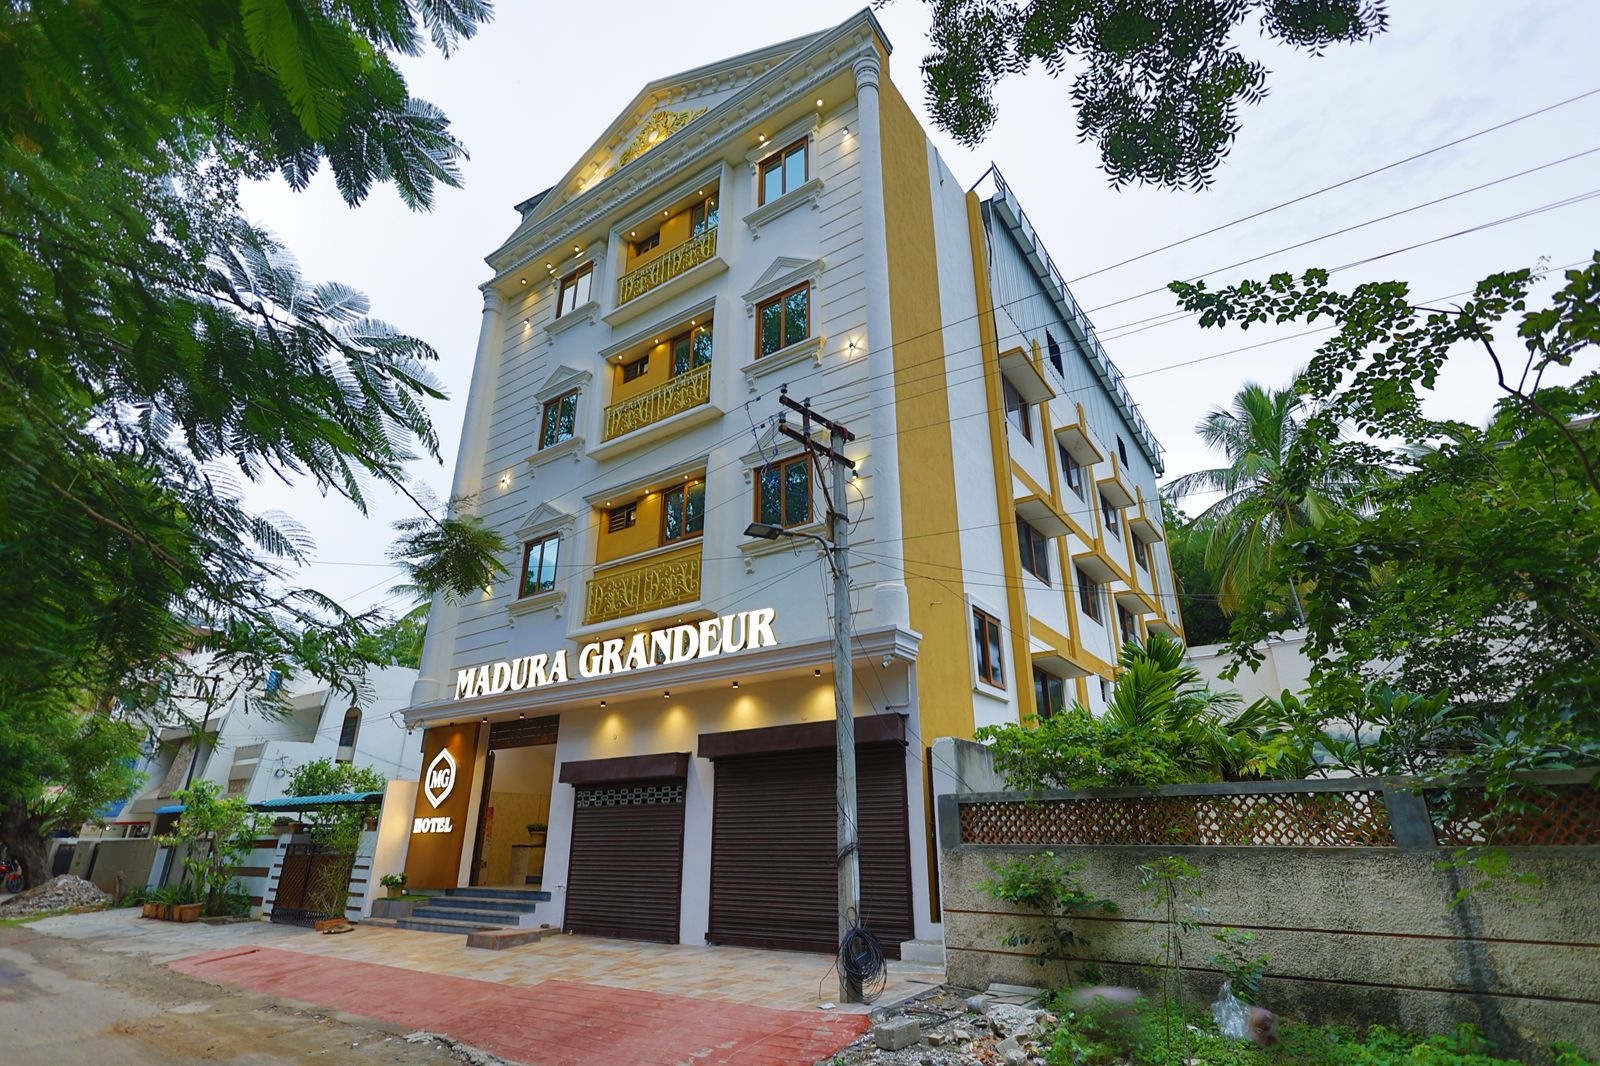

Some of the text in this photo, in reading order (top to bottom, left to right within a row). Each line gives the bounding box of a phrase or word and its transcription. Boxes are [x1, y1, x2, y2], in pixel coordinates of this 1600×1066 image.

[454, 607, 777, 700] MADURA GRANDEUR
[429, 768, 450, 788] MG
[413, 816, 453, 833] HOTEL
